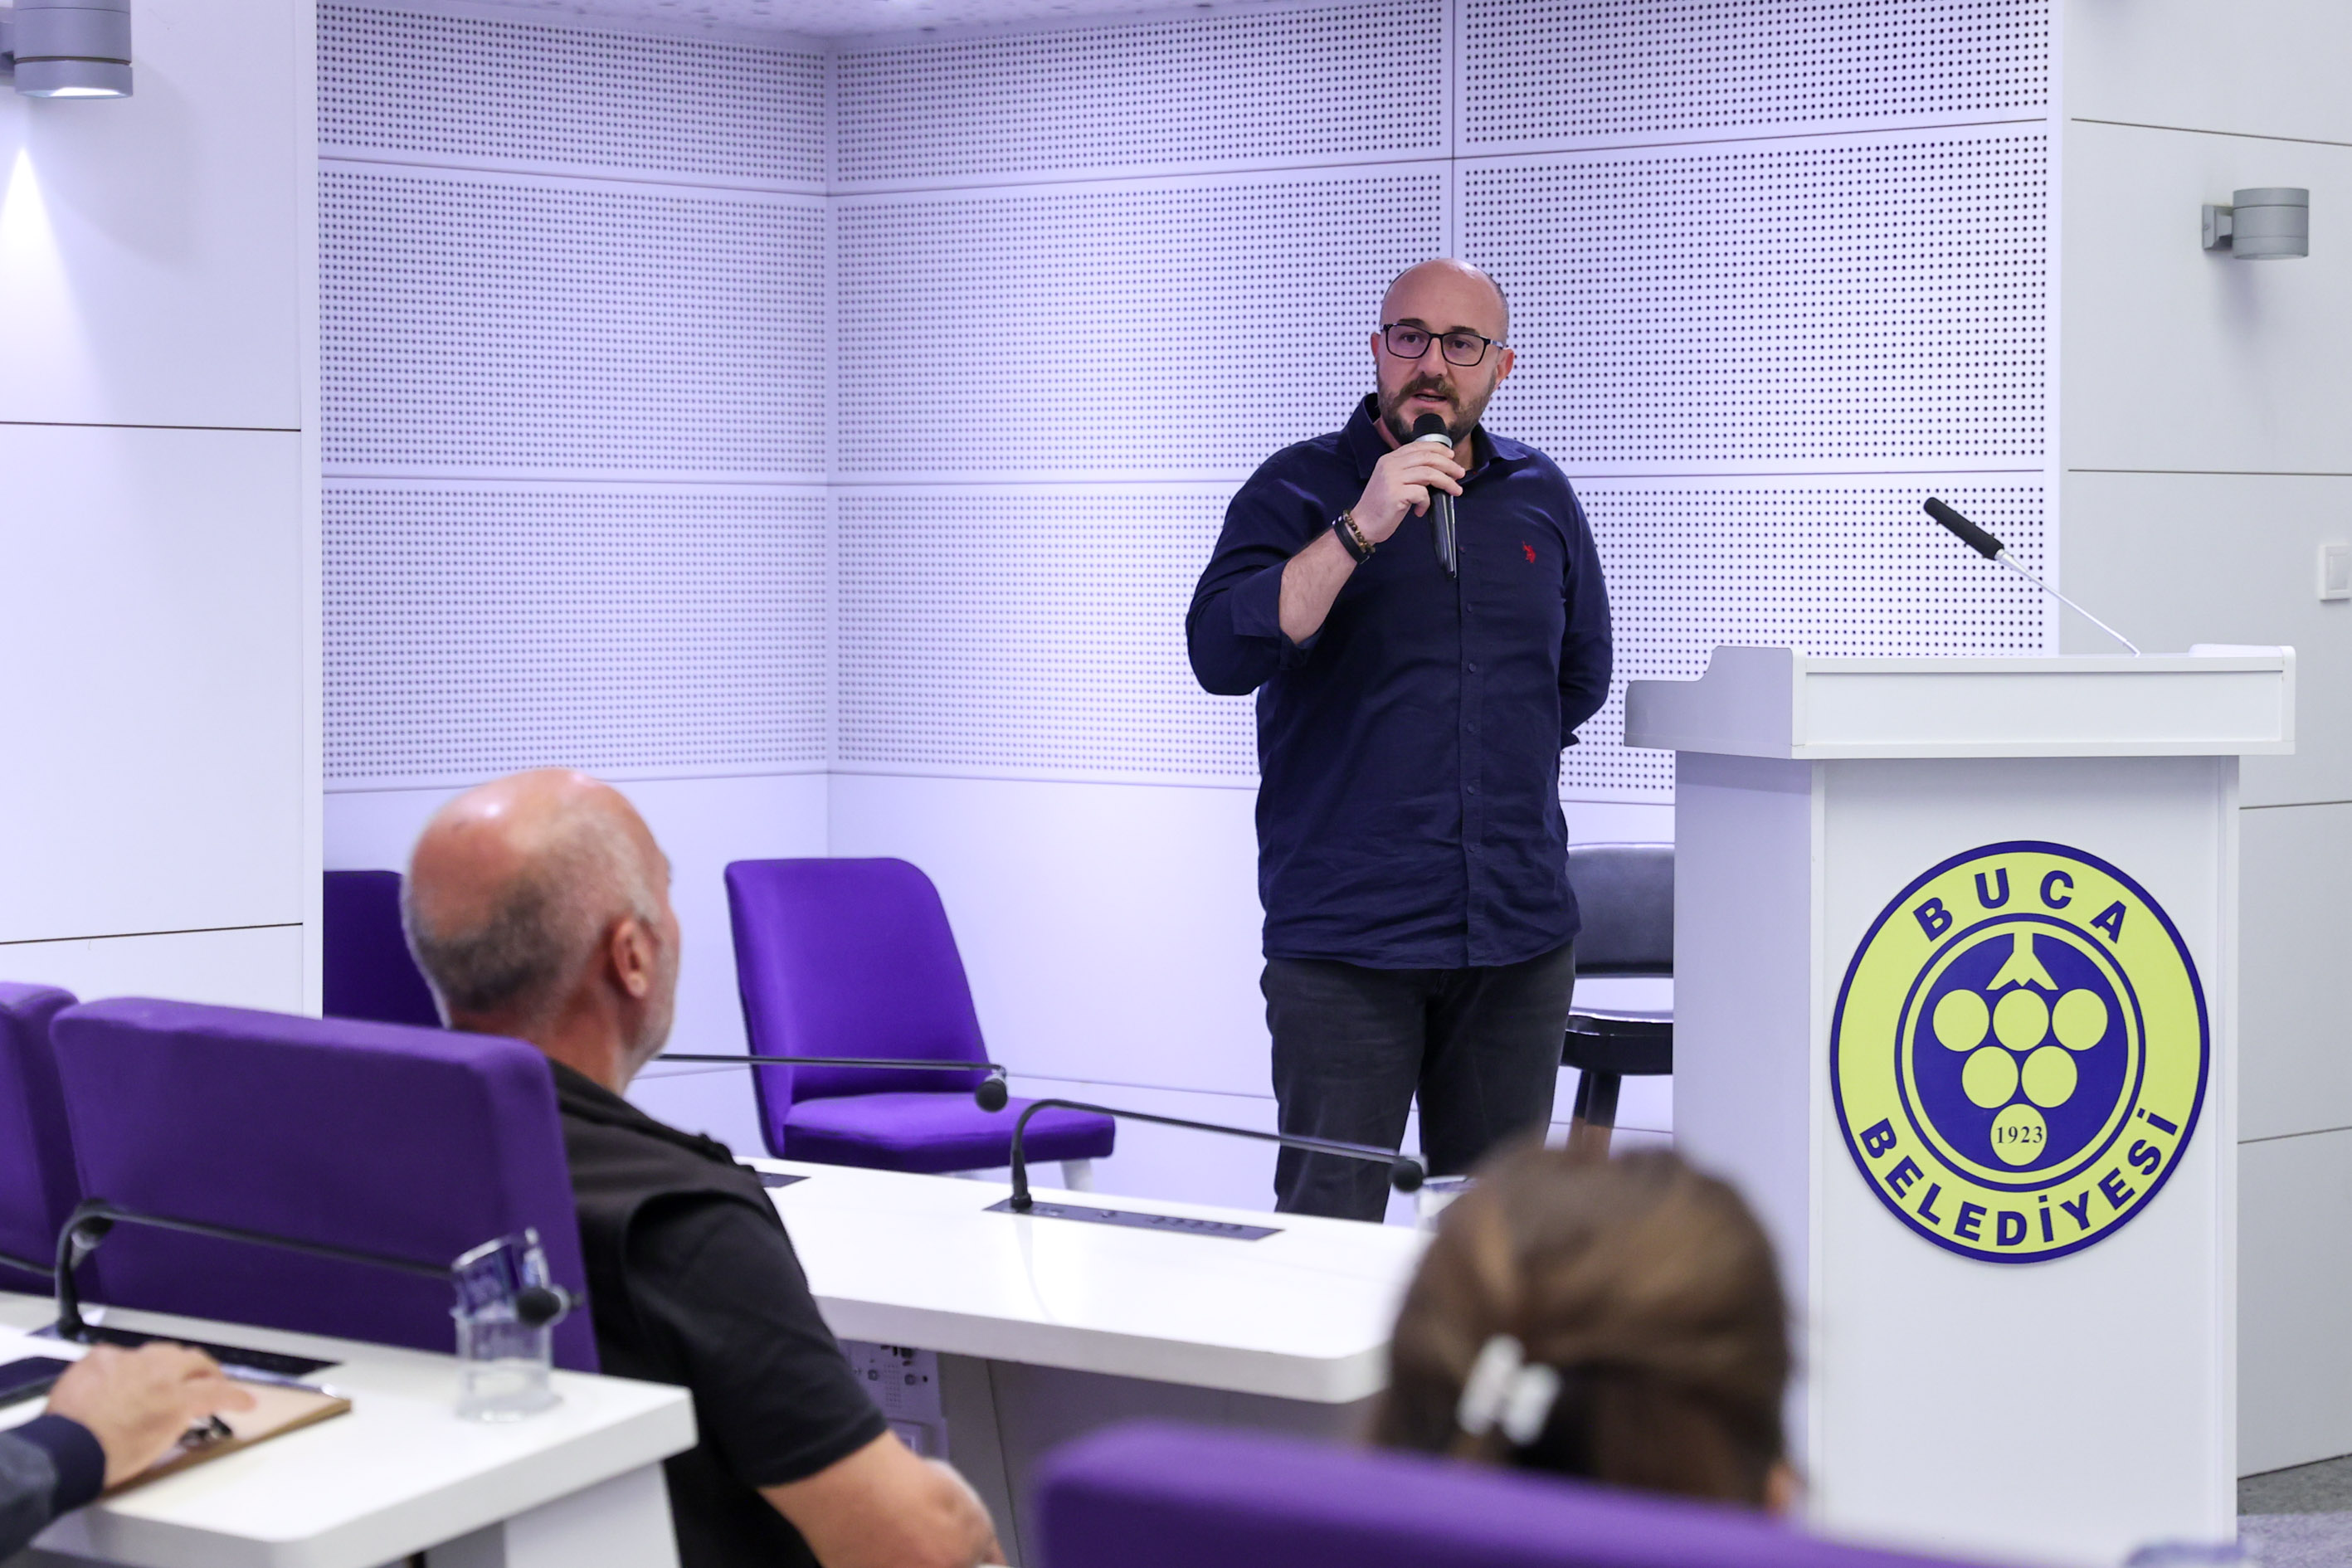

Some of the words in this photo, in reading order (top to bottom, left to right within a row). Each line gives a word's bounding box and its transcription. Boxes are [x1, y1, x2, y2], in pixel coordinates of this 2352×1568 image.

[1912, 868, 2126, 943] BUCA
[1996, 1126, 2043, 1144] 1923
[1859, 1108, 2179, 1246] BELEDİYESİ
